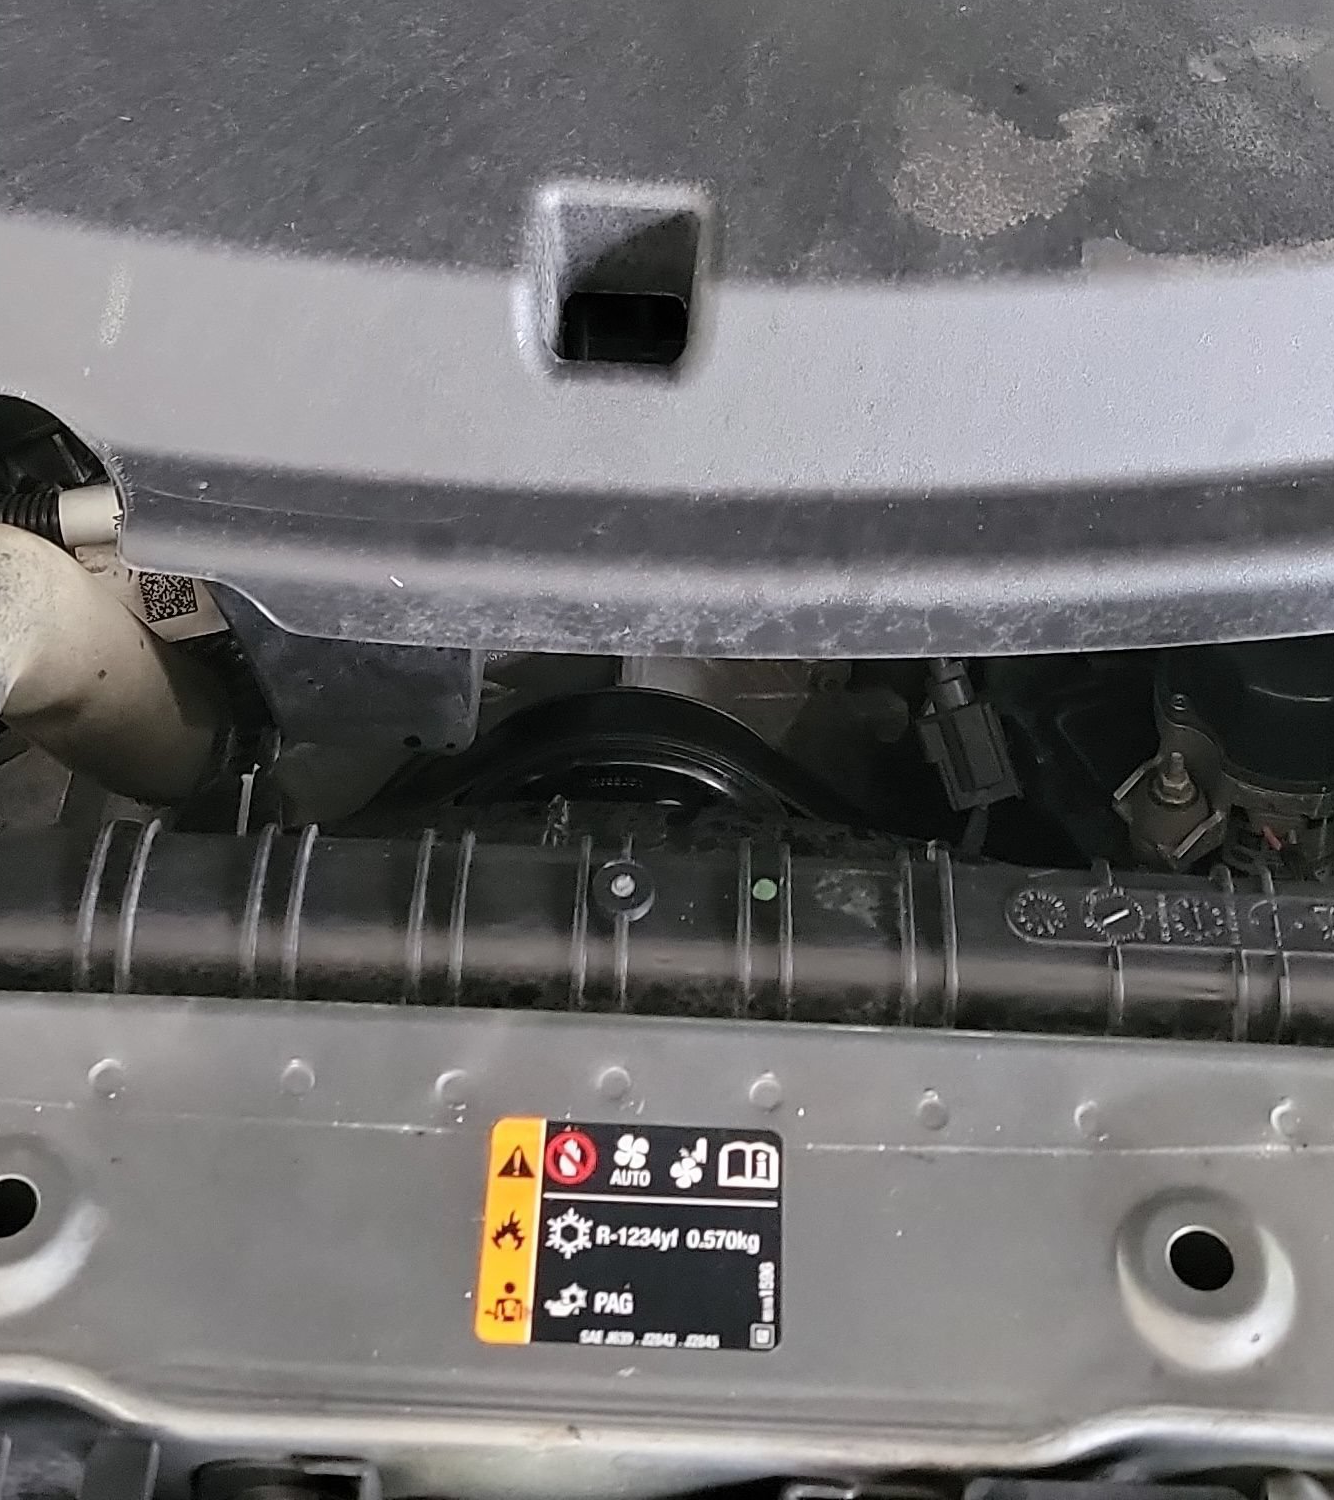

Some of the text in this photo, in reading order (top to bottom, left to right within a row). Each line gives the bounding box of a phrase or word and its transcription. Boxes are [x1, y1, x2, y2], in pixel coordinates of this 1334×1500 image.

[609, 1170, 651, 1187] AUTO
[595, 1226, 761, 1255] R-1234yf 0.570kg
[594, 1291, 634, 1315] PAG
